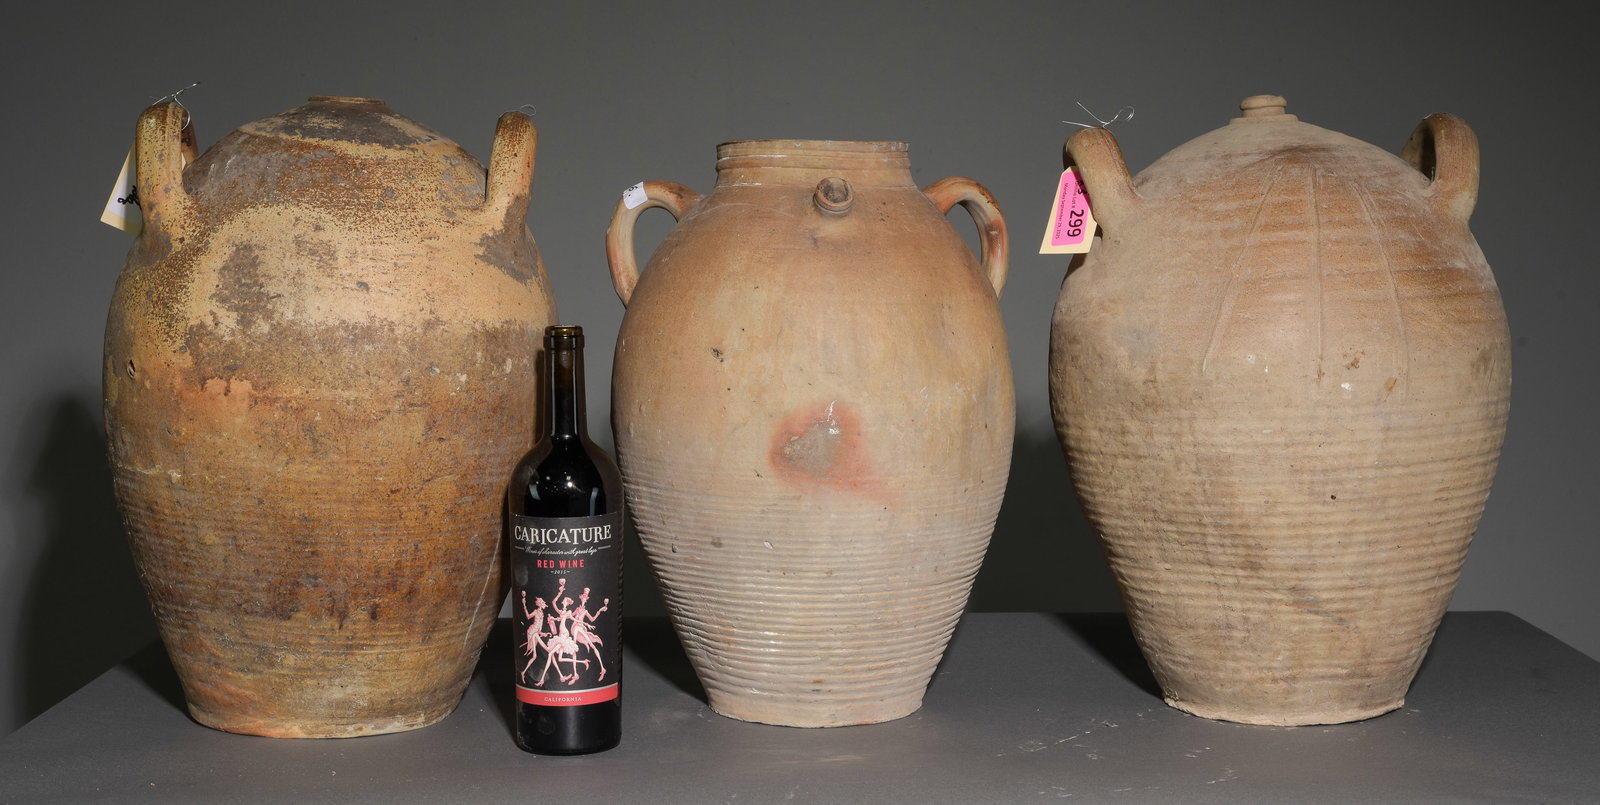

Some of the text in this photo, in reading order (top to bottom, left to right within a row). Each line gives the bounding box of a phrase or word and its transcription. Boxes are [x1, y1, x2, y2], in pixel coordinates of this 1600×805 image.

[1067, 209, 1084, 237] 299
[514, 525, 611, 545] CARICATURE
[537, 559, 585, 569] RED WINE
